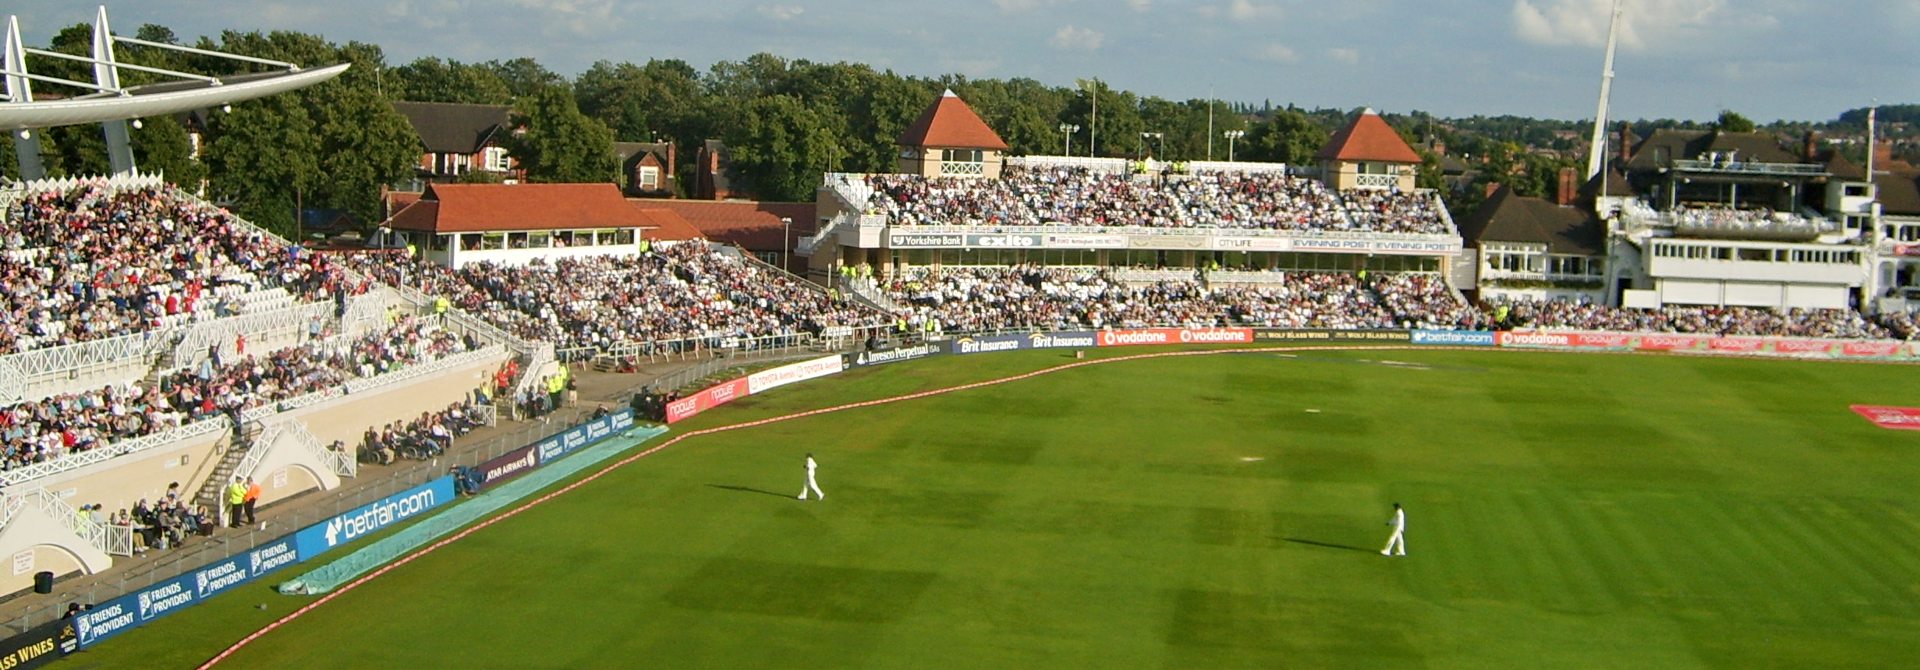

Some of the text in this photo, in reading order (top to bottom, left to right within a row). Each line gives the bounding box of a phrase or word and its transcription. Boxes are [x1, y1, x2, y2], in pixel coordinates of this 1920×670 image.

[905, 235, 961, 246] Yorkshire Bank
[1294, 239, 1371, 248] EVENING POST
[1377, 242, 1422, 250] EVENING
[1033, 335, 1093, 347] Brit Insurance
[1116, 330, 1167, 343] vodafone
[1192, 329, 1245, 341] vodafone
[1427, 331, 1493, 343] betfair.com
[1515, 332, 1568, 345] vodafone
[868, 348, 895, 363] Invesco
[895, 343, 929, 360] Perpetual
[961, 338, 1019, 353] Brit Insurance
[804, 363, 824, 375] TOYOTA
[759, 372, 778, 385] TOYOTA
[711, 384, 735, 402] npower
[669, 397, 697, 417] npower
[485, 457, 527, 482] ATAR AIRWAYS
[344, 488, 435, 539] betfair.com
[261, 542, 288, 559] FRIENDS
[263, 550, 297, 571] PROVIDENT
[208, 561, 236, 580] FRIENDS
[210, 569, 247, 591] PROVIDENT
[151, 582, 181, 601] FRIENDS
[153, 590, 193, 613] PROVIDENT
[91, 603, 122, 624] FRIENDS
[93, 612, 134, 638] PROVIDENT
[17, 637, 54, 663] WINES
